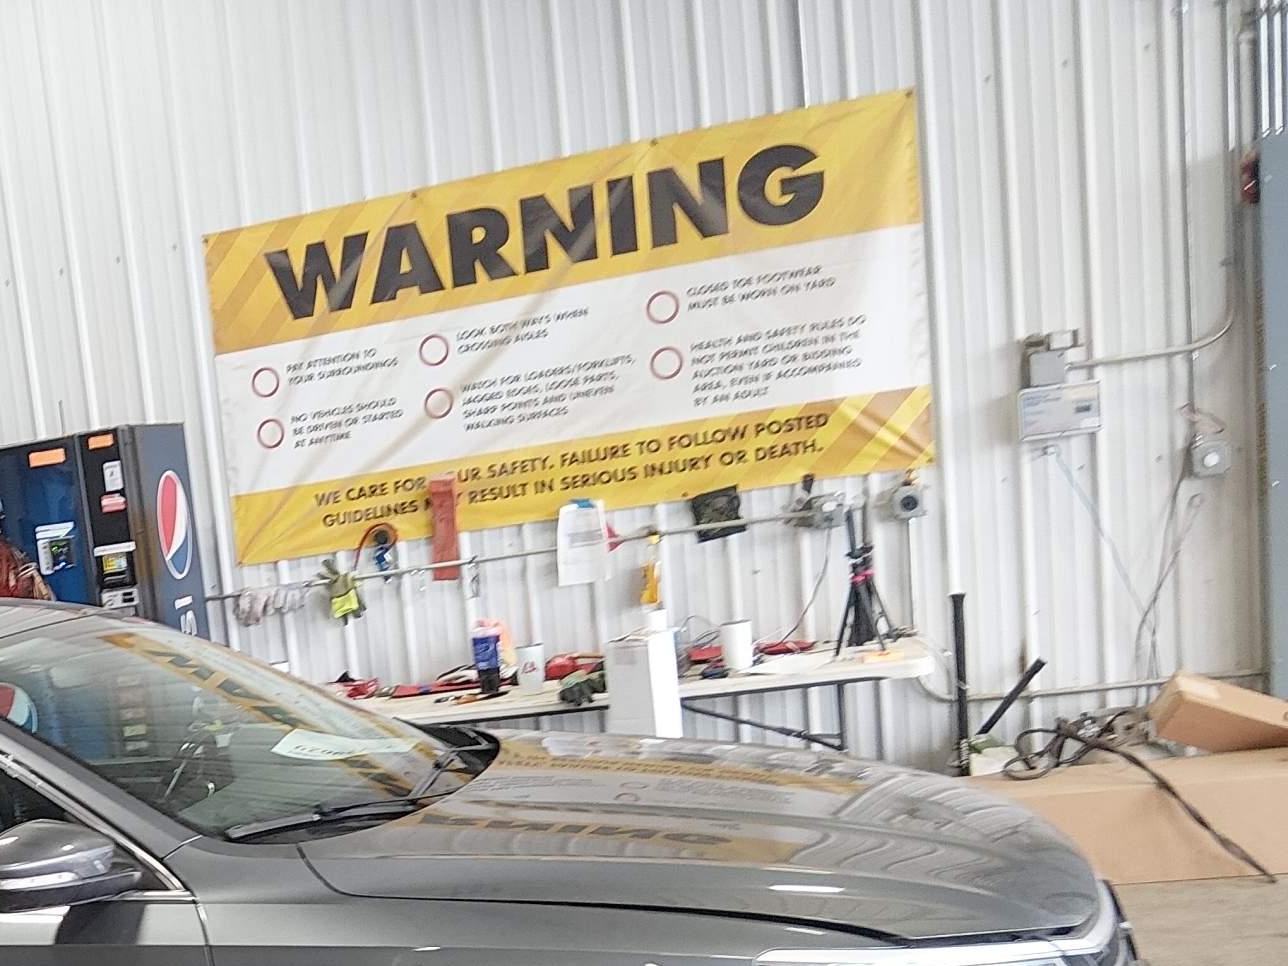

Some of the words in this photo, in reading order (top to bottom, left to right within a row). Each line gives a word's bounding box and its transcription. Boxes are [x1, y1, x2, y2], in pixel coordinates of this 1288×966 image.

[263, 144, 826, 320] WARNING
[314, 490, 341, 507] WE
[345, 481, 389, 502] CARE
[393, 476, 428, 495] FOR
[559, 443, 631, 469] FAILURE
[634, 438, 661, 455] TO
[666, 423, 750, 451] FOLLOW
[753, 412, 830, 439] POSTED
[322, 499, 423, 528] GUIDELINES
[467, 482, 529, 505] RESULT
[533, 478, 555, 495] IN
[559, 465, 639, 492] SERIOUS
[643, 453, 713, 479] INJURY
[719, 449, 748, 467] OR
[754, 438, 825, 462] DEATH.
